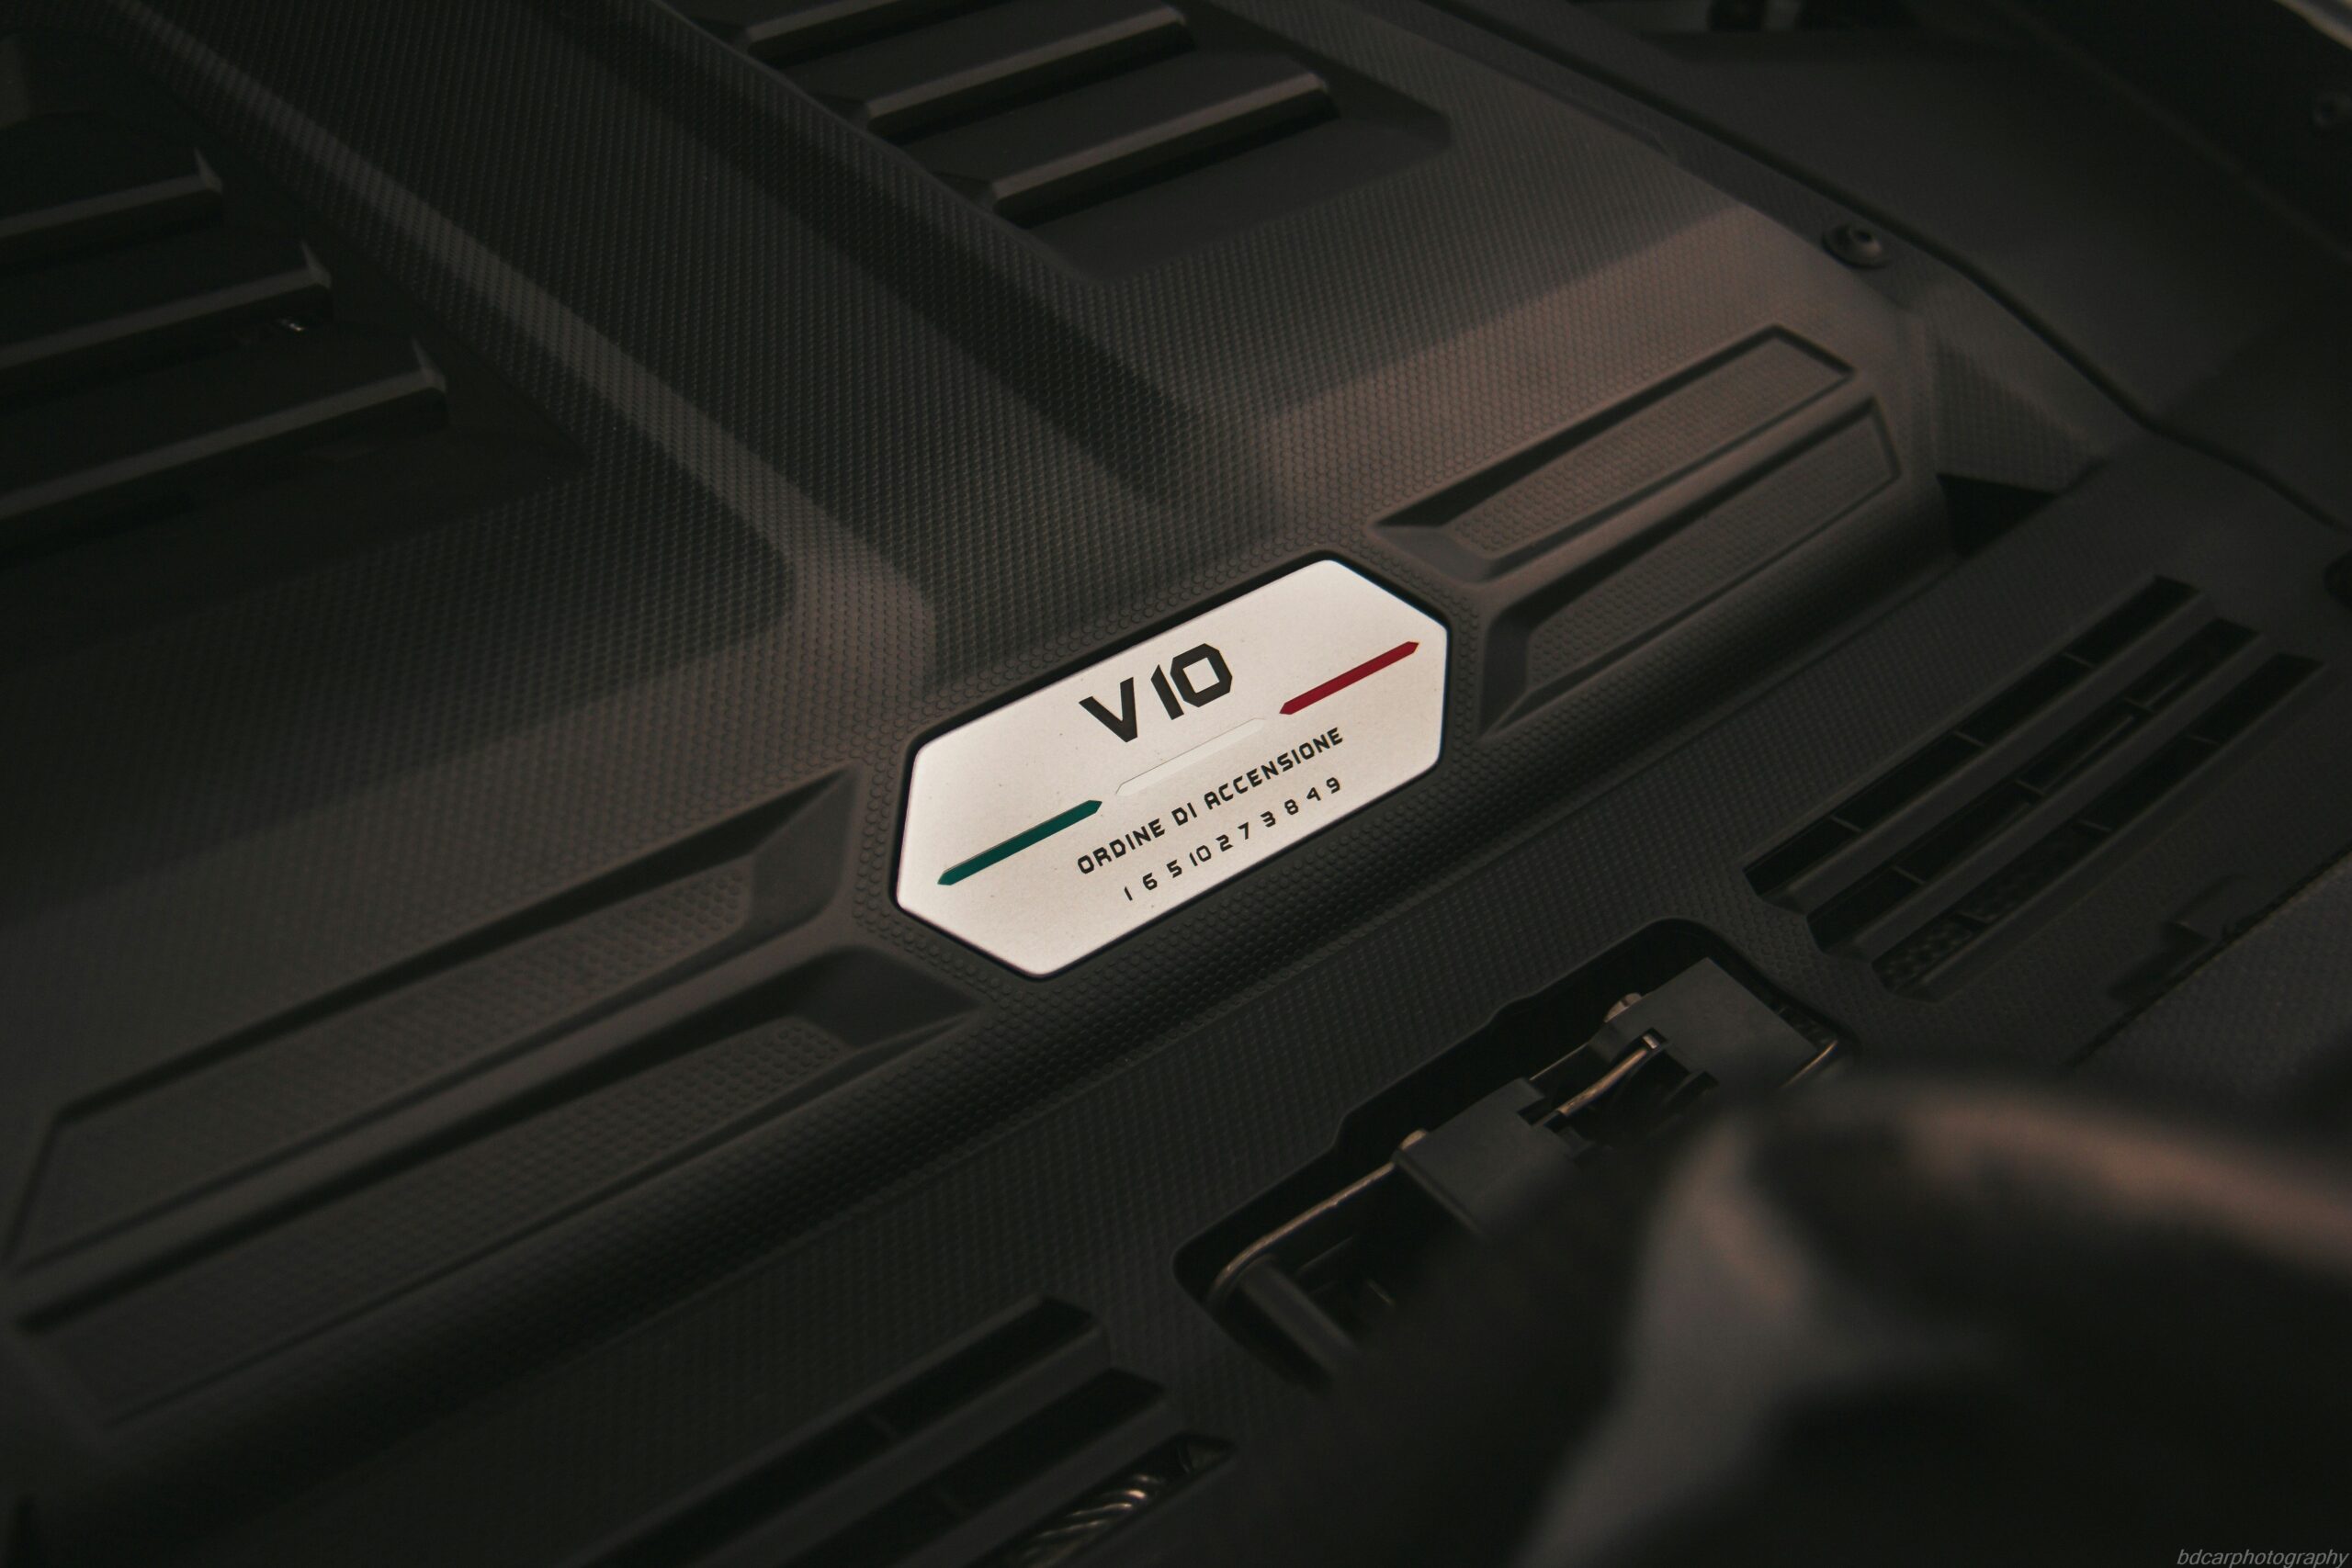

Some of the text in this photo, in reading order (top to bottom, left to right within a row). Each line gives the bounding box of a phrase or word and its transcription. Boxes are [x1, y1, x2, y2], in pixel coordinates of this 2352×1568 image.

[1078, 642, 1233, 743] V10
[1077, 727, 1343, 874] ORDINE DI ACCENSIONE
[1124, 776, 1340, 901] 1 6 5 10 2 7 3 8 4 9
